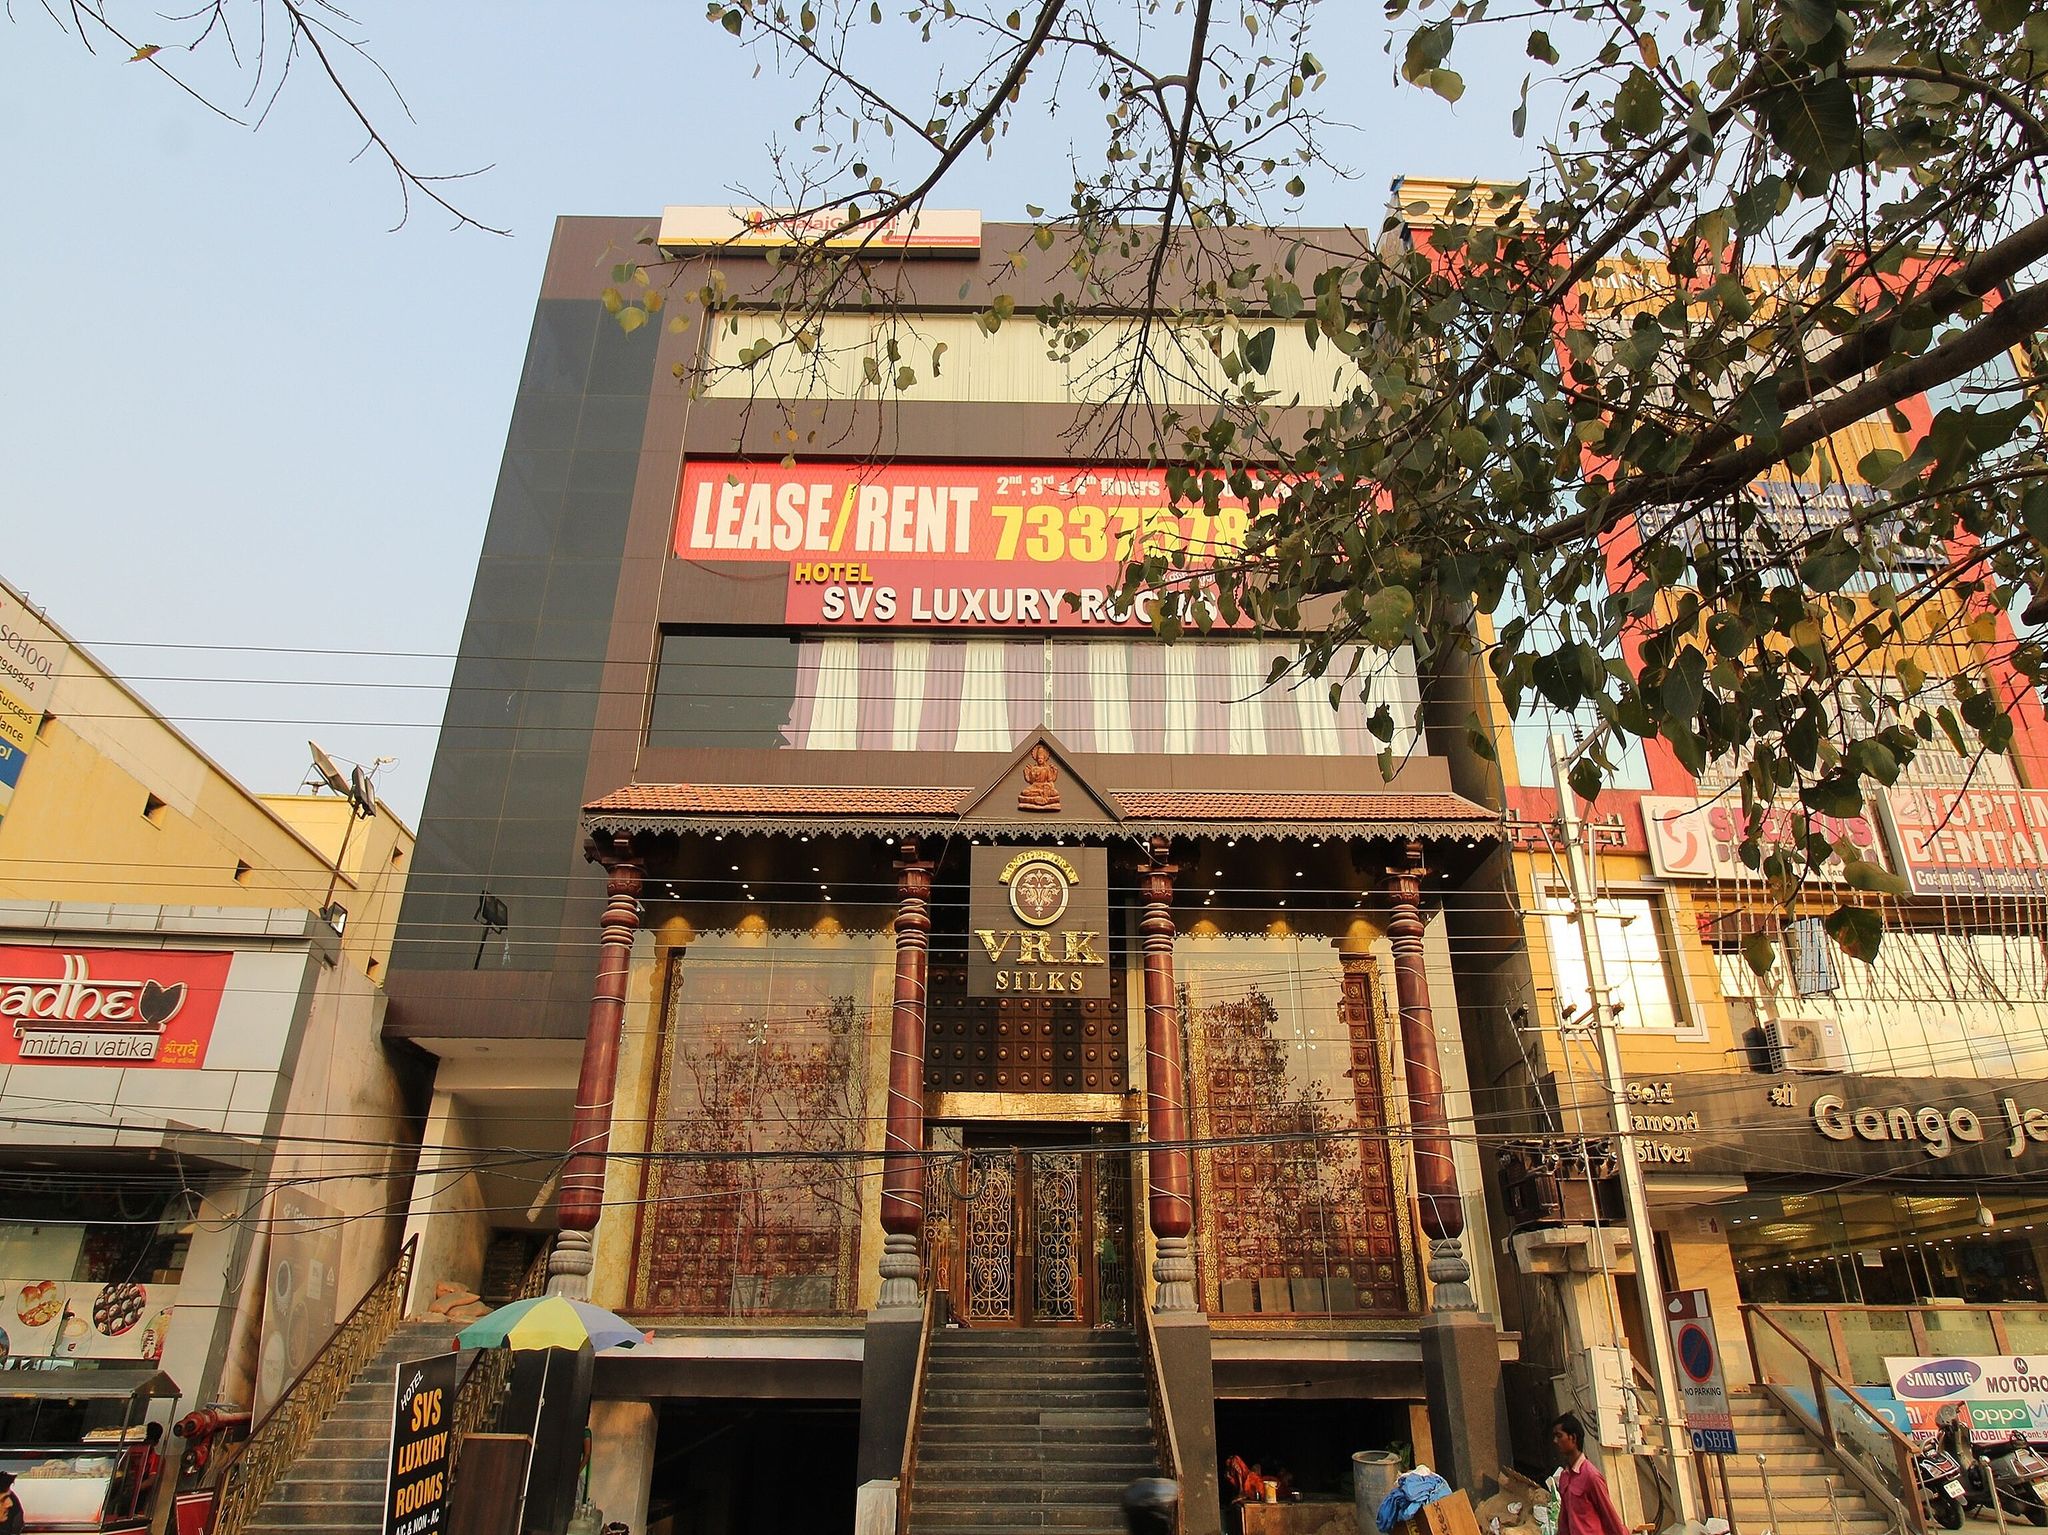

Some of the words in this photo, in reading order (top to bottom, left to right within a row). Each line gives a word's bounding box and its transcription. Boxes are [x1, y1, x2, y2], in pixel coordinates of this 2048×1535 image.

[1030, 475, 1054, 496] 3rd
[795, 562, 874, 583] HOTEL
[821, 586, 897, 621] SVS
[912, 587, 1067, 622] LUXURY
[0, 624, 53, 680] SCHOOL
[974, 929, 1105, 965] VRK
[0, 954, 136, 1020] adhe
[996, 970, 1083, 992] SILKS
[23, 1033, 91, 1056] mithai
[95, 1036, 154, 1057] vatika
[1626, 1082, 1675, 1104] Gold
[1813, 1094, 1984, 1159] Ganga
[401, 1370, 424, 1411] HOTEL
[1685, 1387, 1694, 1396] NO
[1695, 1387, 1722, 1396] PARKING
[1905, 1371, 1974, 1387] SAMSUNG
[411, 1388, 442, 1432] SVS
[1972, 1408, 2026, 1425] oppo
[398, 1431, 448, 1475] LUXURY
[1705, 1430, 1732, 1449] SBH
[395, 1471, 444, 1518] ROOMS
